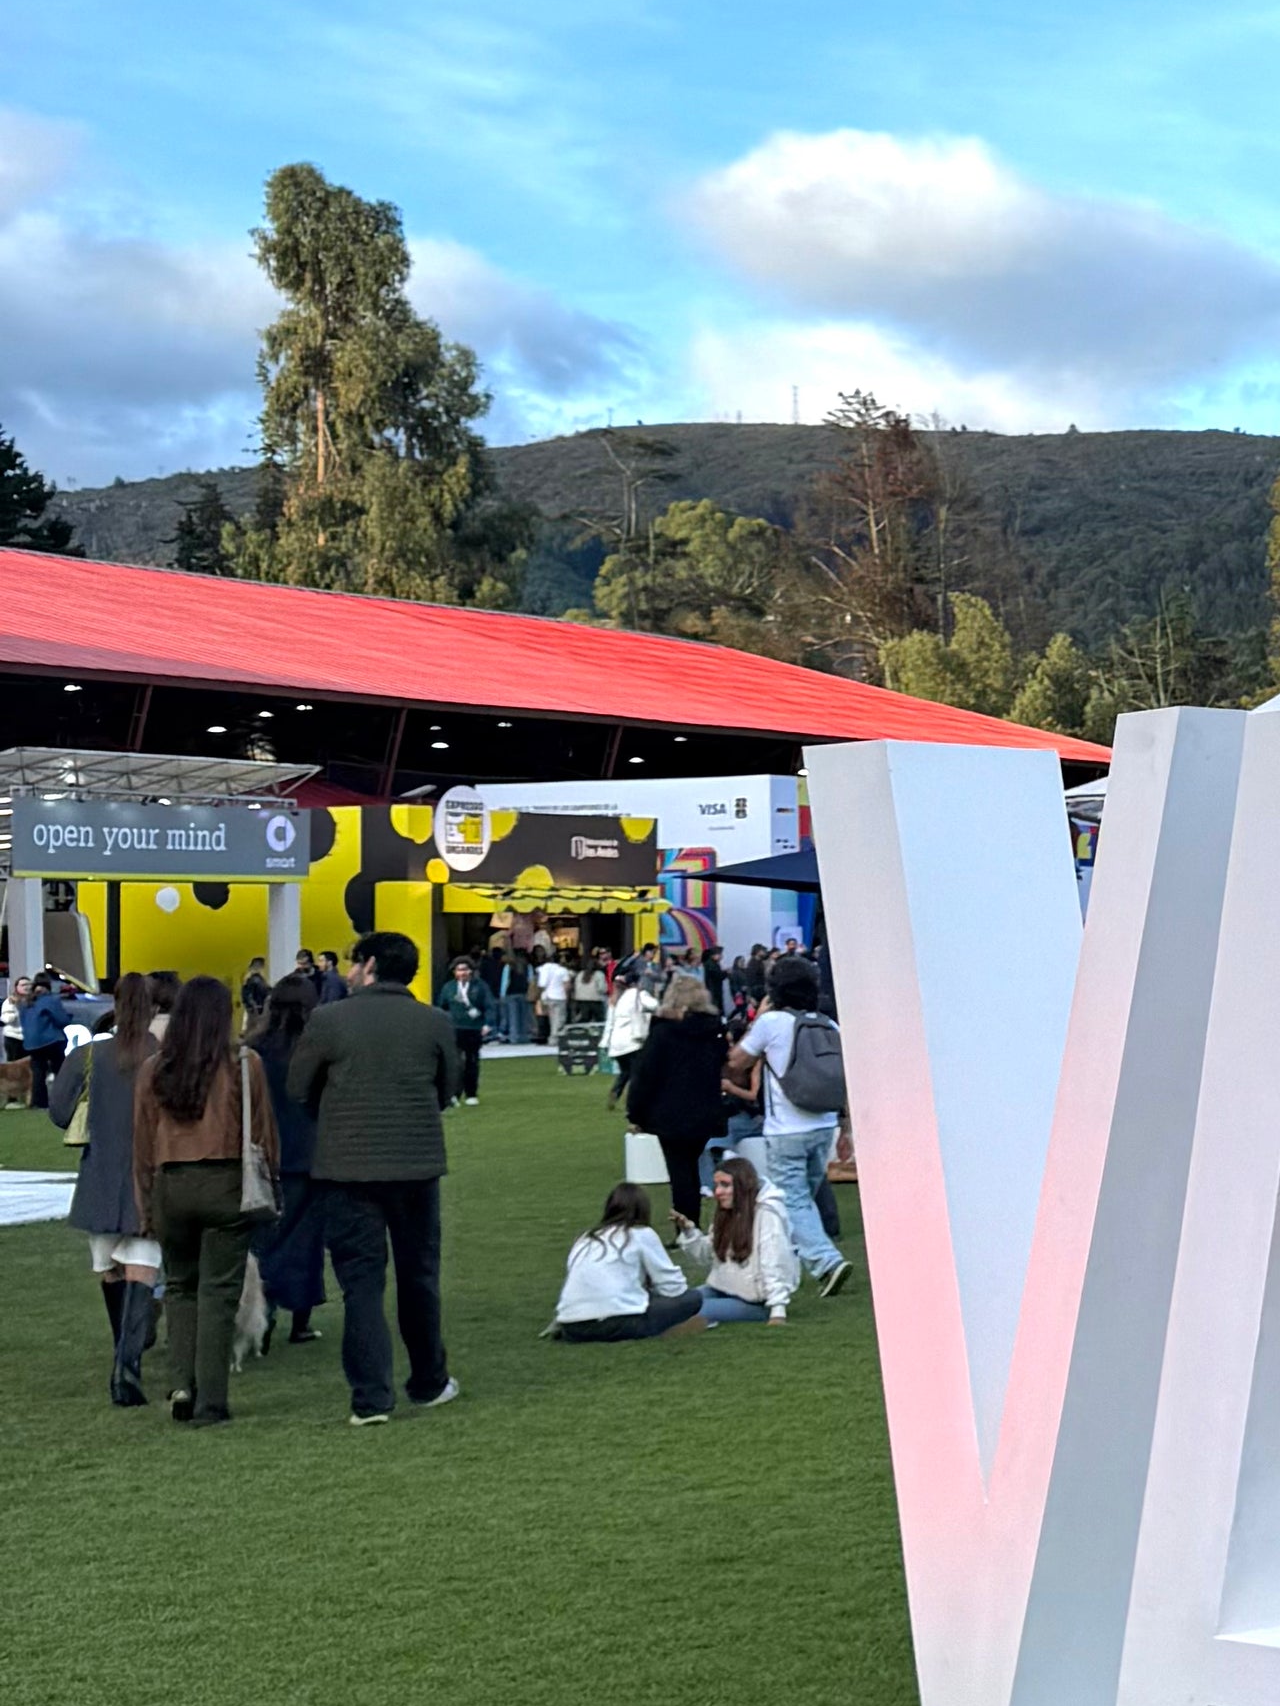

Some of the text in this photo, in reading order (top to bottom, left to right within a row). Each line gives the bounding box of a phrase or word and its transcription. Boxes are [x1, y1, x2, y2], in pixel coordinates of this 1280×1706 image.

[699, 803, 727, 815] VISA
[33, 822, 226, 855] open your mind
